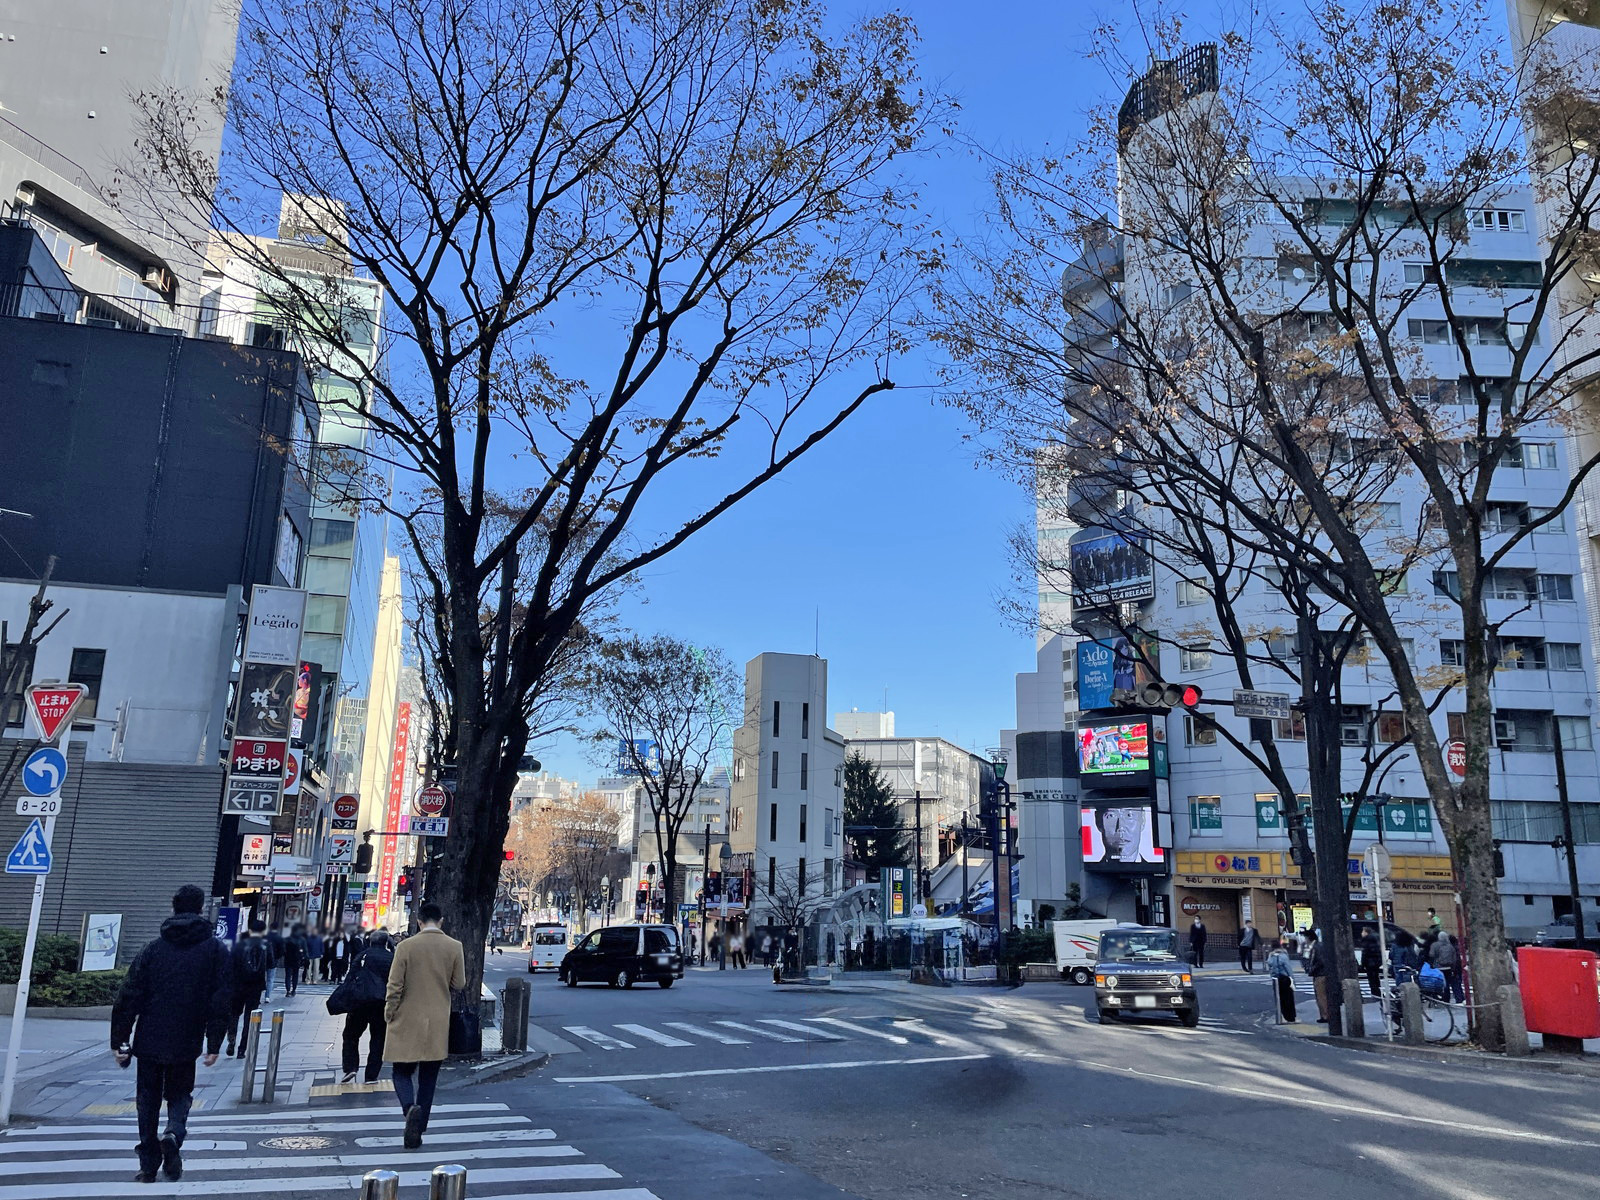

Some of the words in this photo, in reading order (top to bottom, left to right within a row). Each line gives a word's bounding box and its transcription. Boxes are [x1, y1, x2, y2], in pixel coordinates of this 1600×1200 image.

[1125, 587, 1151, 599] RELEASE
[39, 695, 70, 706] 止まれ
[43, 708, 64, 718] STOP
[236, 756, 281, 772] やまや
[259, 794, 273, 808] P
[421, 795, 444, 806] 消火栓
[21, 801, 56, 812] 8-20
[413, 823, 445, 832] KEN
[1232, 856, 1260, 871] 松屋
